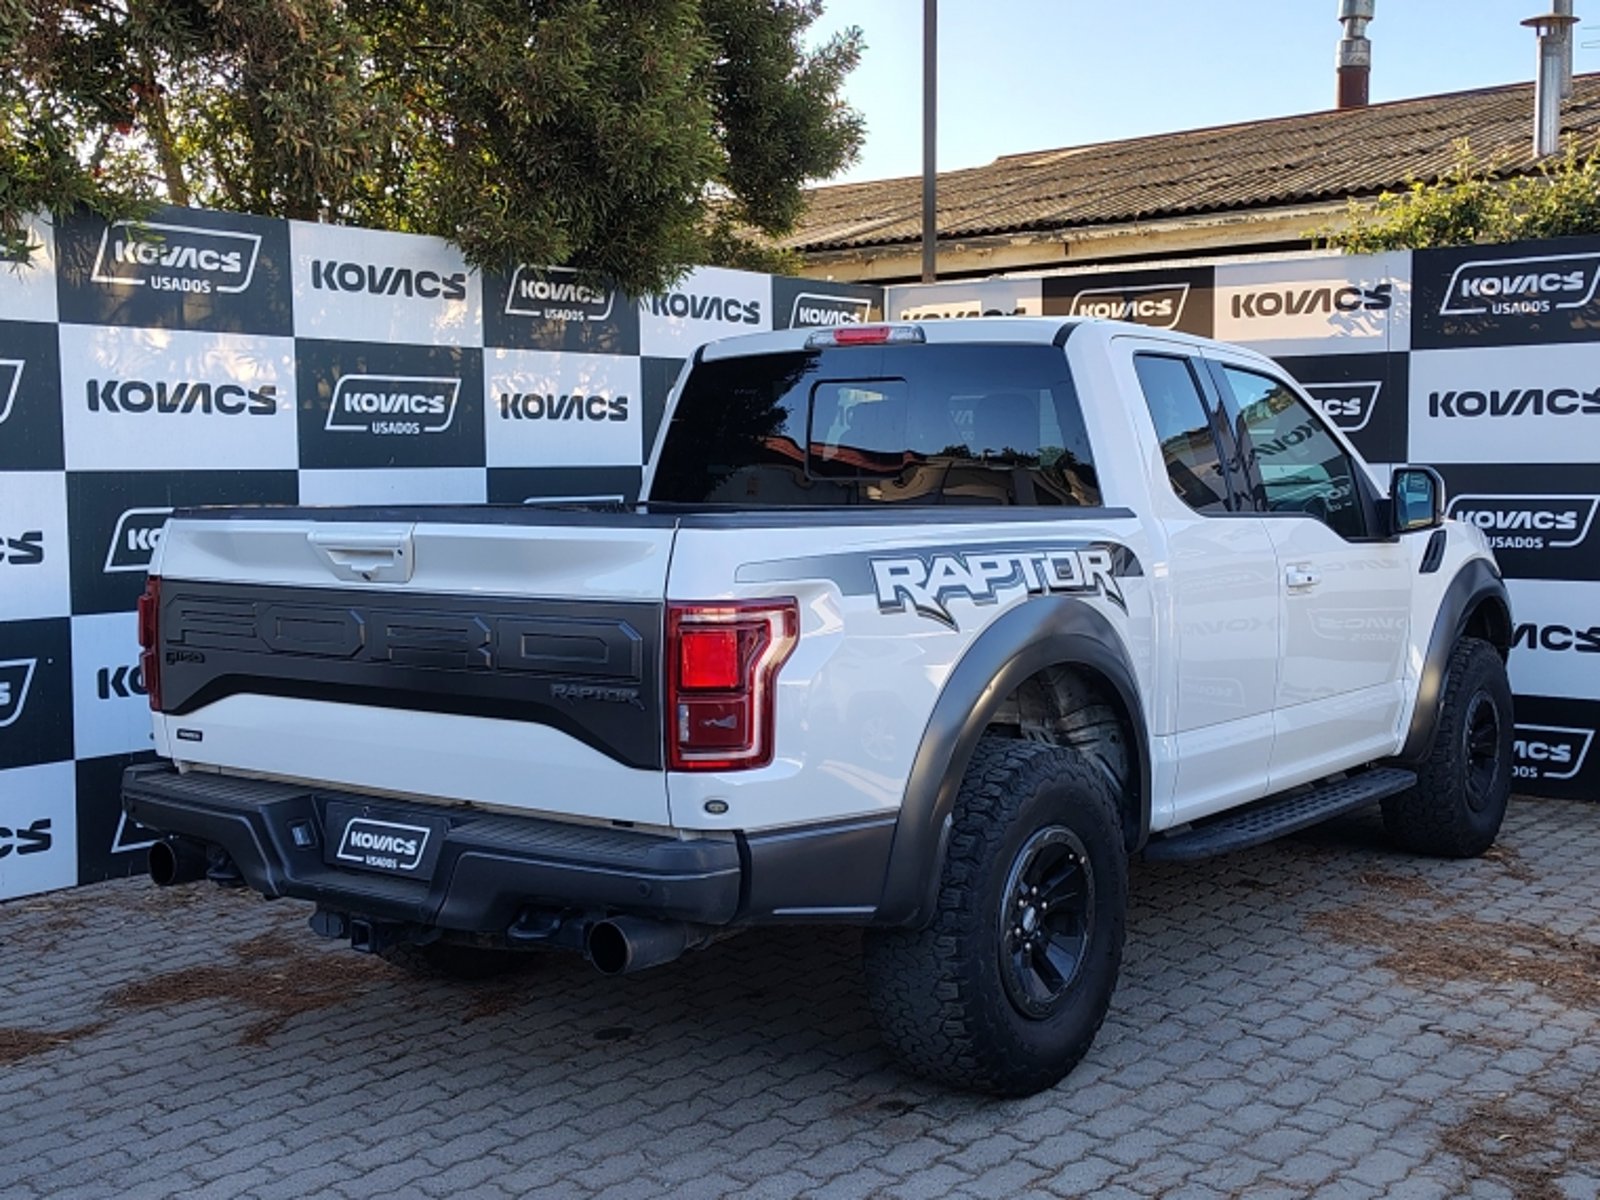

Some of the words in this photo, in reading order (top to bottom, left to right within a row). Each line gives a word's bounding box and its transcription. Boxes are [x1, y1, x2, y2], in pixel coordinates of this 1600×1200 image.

[115, 240, 241, 272] KOVACS
[151, 275, 211, 293] USADOS
[312, 260, 466, 300] KOVACS
[1461, 271, 1584, 298] KOVACS
[652, 292, 760, 325] KOVACS
[1080, 299, 1172, 318] KOVACS
[1231, 283, 1392, 319] KOVACS
[1492, 301, 1550, 316] USADOS
[545, 308, 584, 322] USADOS
[800, 307, 860, 326] KOVACS
[86, 379, 277, 415] KOVACS
[344, 392, 445, 414] KOVACS
[501, 393, 628, 421] KOVACS
[372, 422, 420, 435] USADOS
[1456, 511, 1578, 529] KOVACS
[869, 550, 1128, 631] RAPTOR
[166, 593, 643, 683] FORD
[1511, 622, 1600, 653] ACS
[550, 683, 646, 711] RAPTOR
[351, 831, 417, 855] KOVACS
